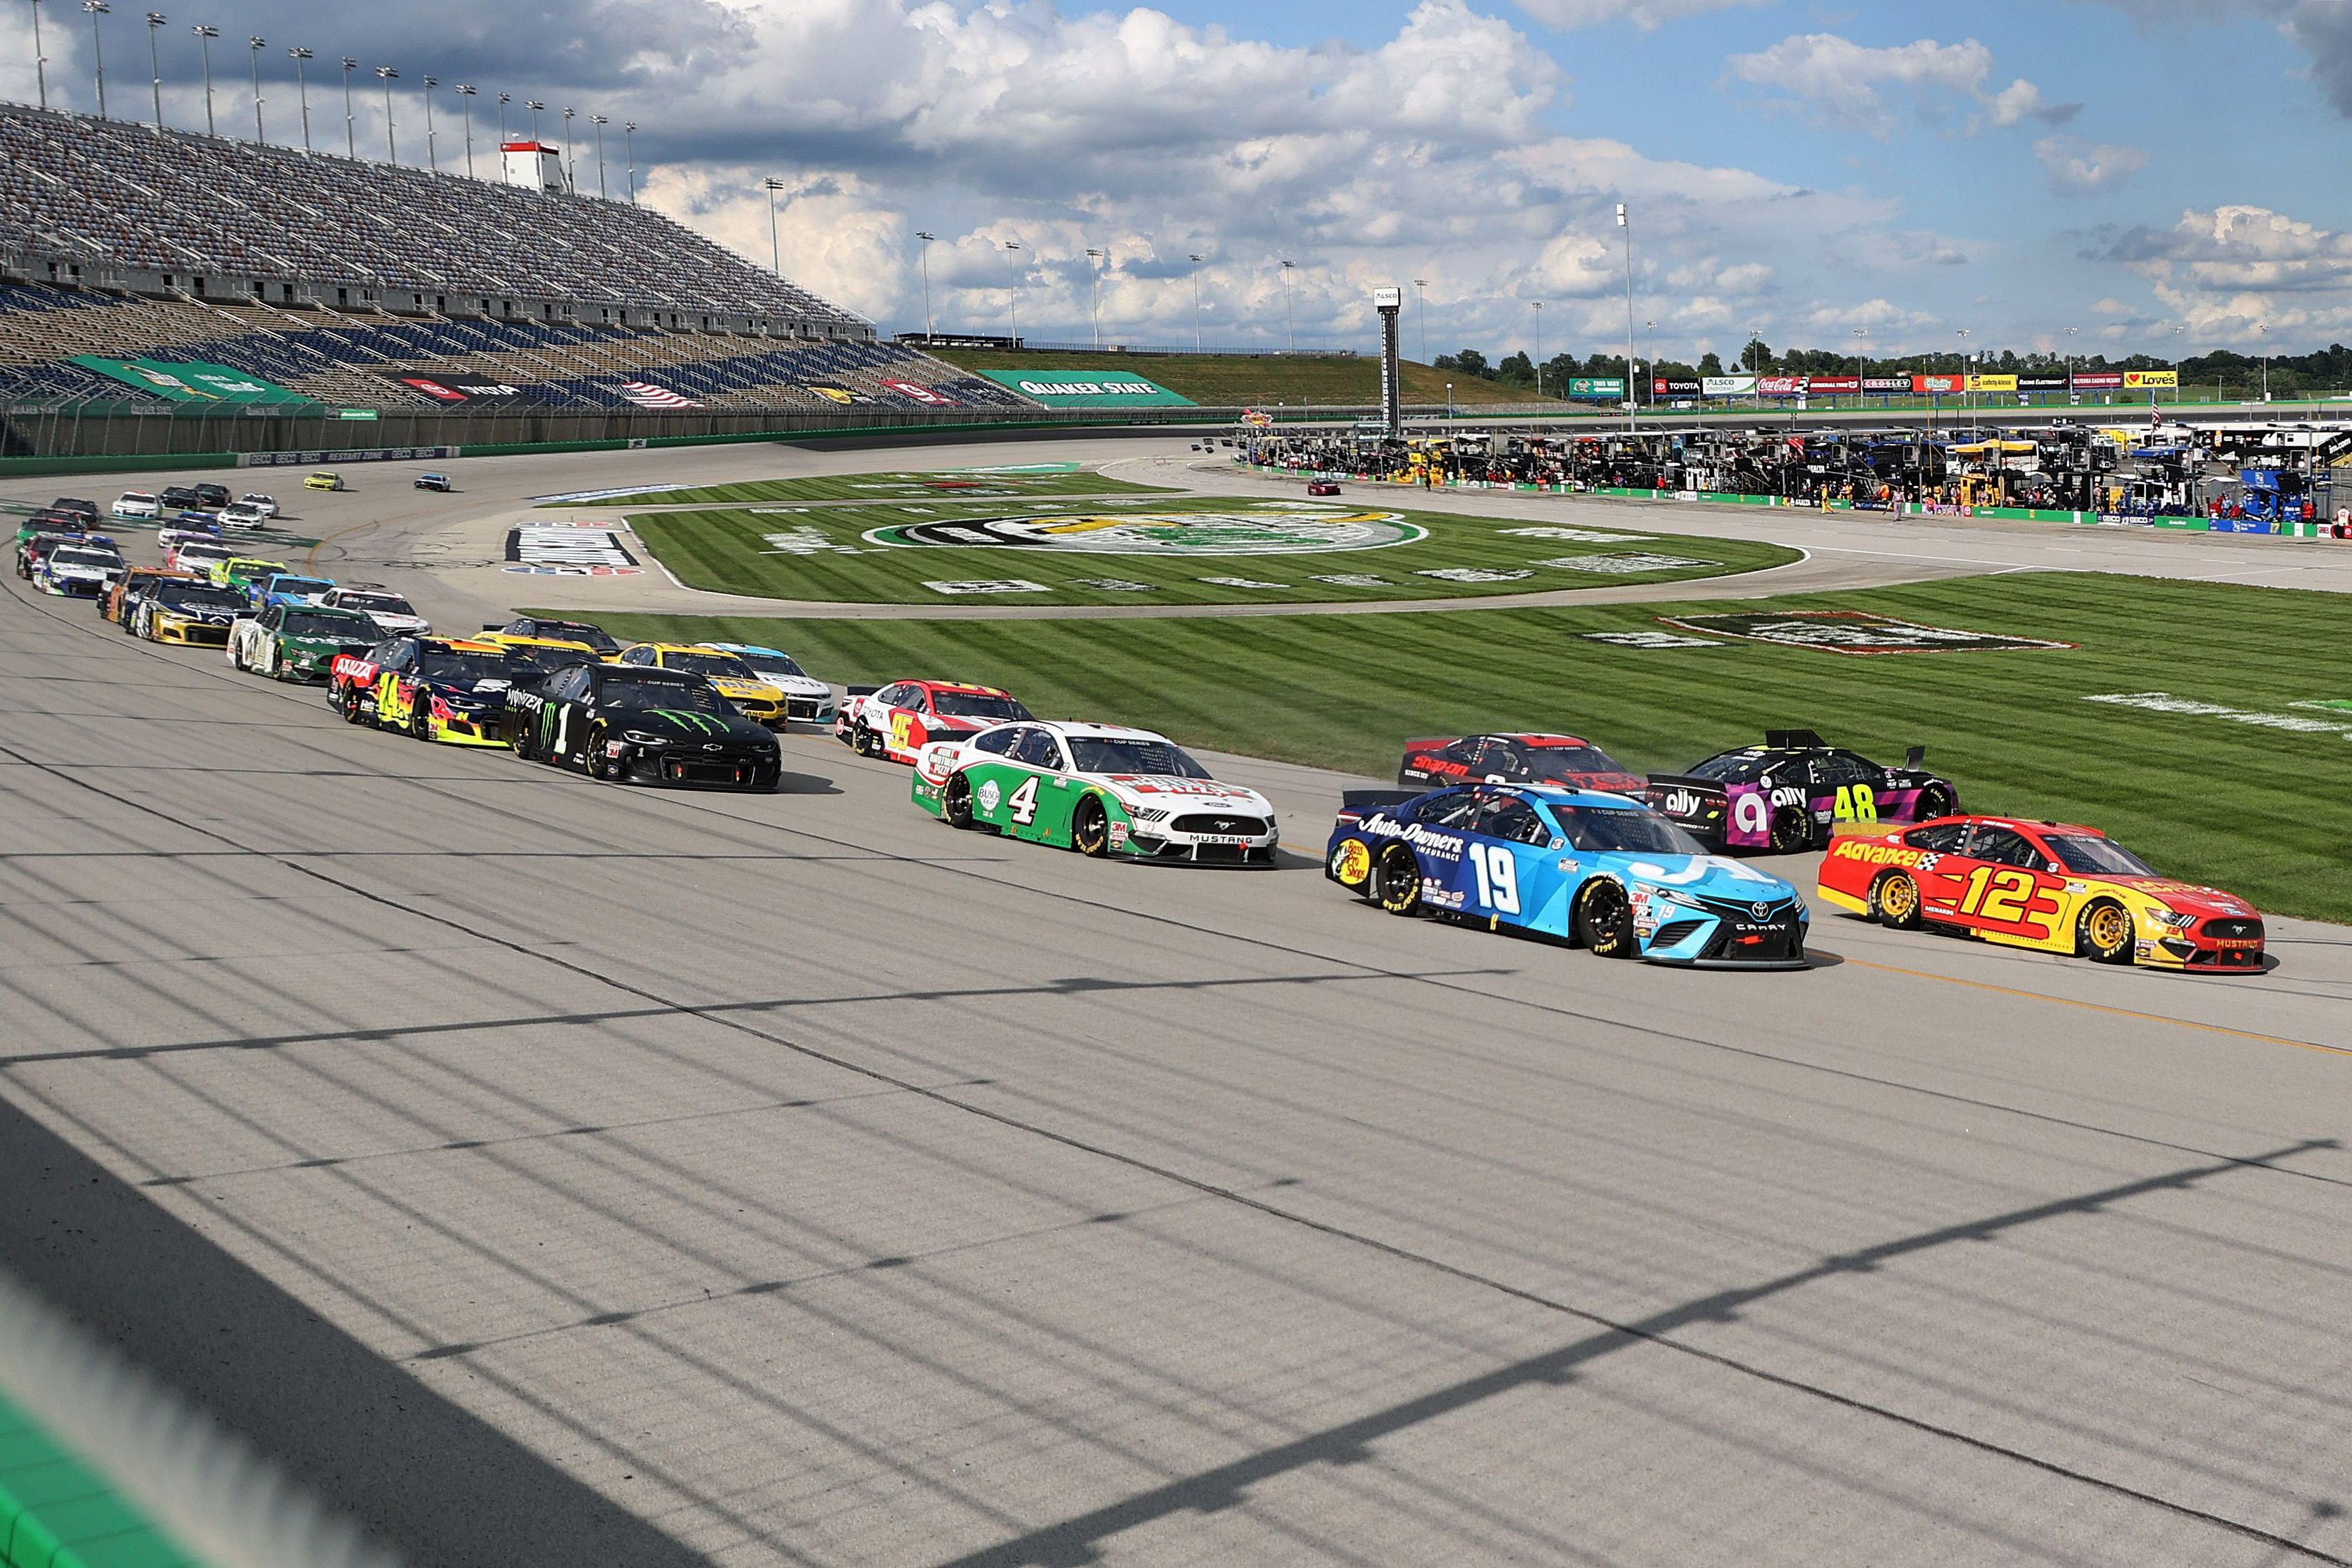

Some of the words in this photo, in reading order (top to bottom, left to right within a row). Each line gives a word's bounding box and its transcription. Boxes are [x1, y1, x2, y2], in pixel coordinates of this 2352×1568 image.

[1019, 380, 1105, 395] QUAKER
[1102, 382, 1158, 394] STATE
[1757, 378, 1793, 391] Coca-Cola
[252, 455, 271, 464] GEICO
[276, 454, 296, 463] GEICO
[300, 453, 320, 462] GEICO
[392, 450, 411, 459] GEICO
[415, 449, 435, 457] GEICO
[379, 672, 410, 729] 24
[455, 712, 469, 720] 24
[861, 705, 884, 722] TOYOTA
[554, 702, 571, 754] 1
[889, 712, 913, 751] 95
[607, 748, 618, 757] 3M
[978, 787, 1001, 799] BUSCH
[1007, 774, 1040, 826] 4
[1771, 786, 1806, 809] ally
[1666, 789, 1701, 817] ally
[1834, 784, 1877, 824] 48
[1111, 822, 1126, 832] 3M
[1359, 813, 1464, 853] Auto-Owners
[1189, 834, 1253, 843] MUSTANG
[1348, 841, 1363, 855] Bass
[1416, 845, 1460, 862] INSURANCE
[1834, 840, 1917, 867] Advance
[1347, 855, 1359, 866] Pro
[1346, 866, 1365, 881] Shops
[1468, 841, 1521, 915] 19
[1630, 893, 1650, 904] 3M
[1871, 877, 1881, 903] EAGLE
[1959, 866, 2036, 924] 12
[1897, 874, 1920, 924] GOODYEAR
[1657, 905, 1676, 918] 19
[1924, 905, 1954, 916] MENARDS
[2079, 903, 2094, 930] EAGLE
[2103, 908, 2130, 957] GOODYEAR
[1595, 938, 1618, 952] EAGLE
[2216, 940, 2259, 948] MUSTANG
